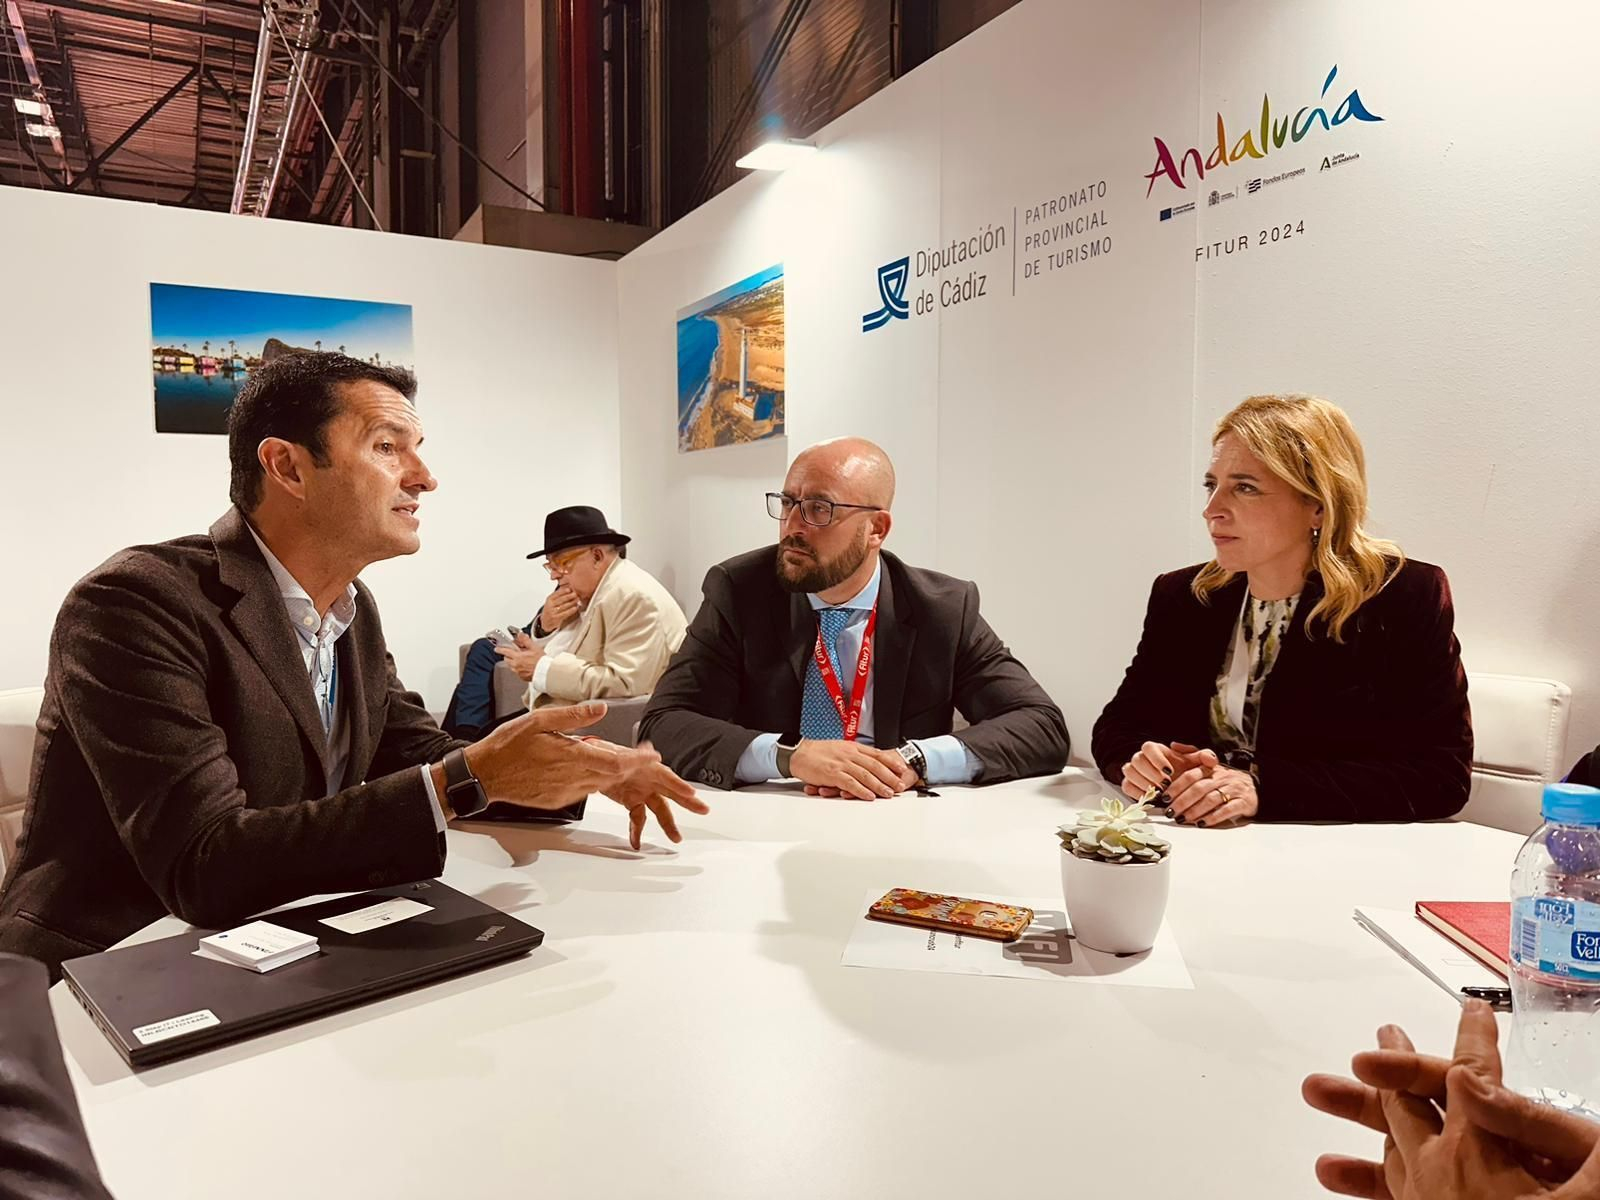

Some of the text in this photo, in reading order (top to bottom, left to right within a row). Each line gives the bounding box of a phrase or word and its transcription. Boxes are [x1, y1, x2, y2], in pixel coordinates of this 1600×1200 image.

[1144, 64, 1386, 200] Andalucía
[1262, 167, 1306, 186] Fondos Europeos
[1025, 180, 1108, 225] PATRONATO
[916, 224, 1006, 277] Diputación
[1025, 209, 1108, 252] PROVINCIAL
[1195, 220, 1305, 262] FITUR 2024
[1024, 236, 1112, 279] DE TURISMO
[916, 271, 987, 316] de Cádiz
